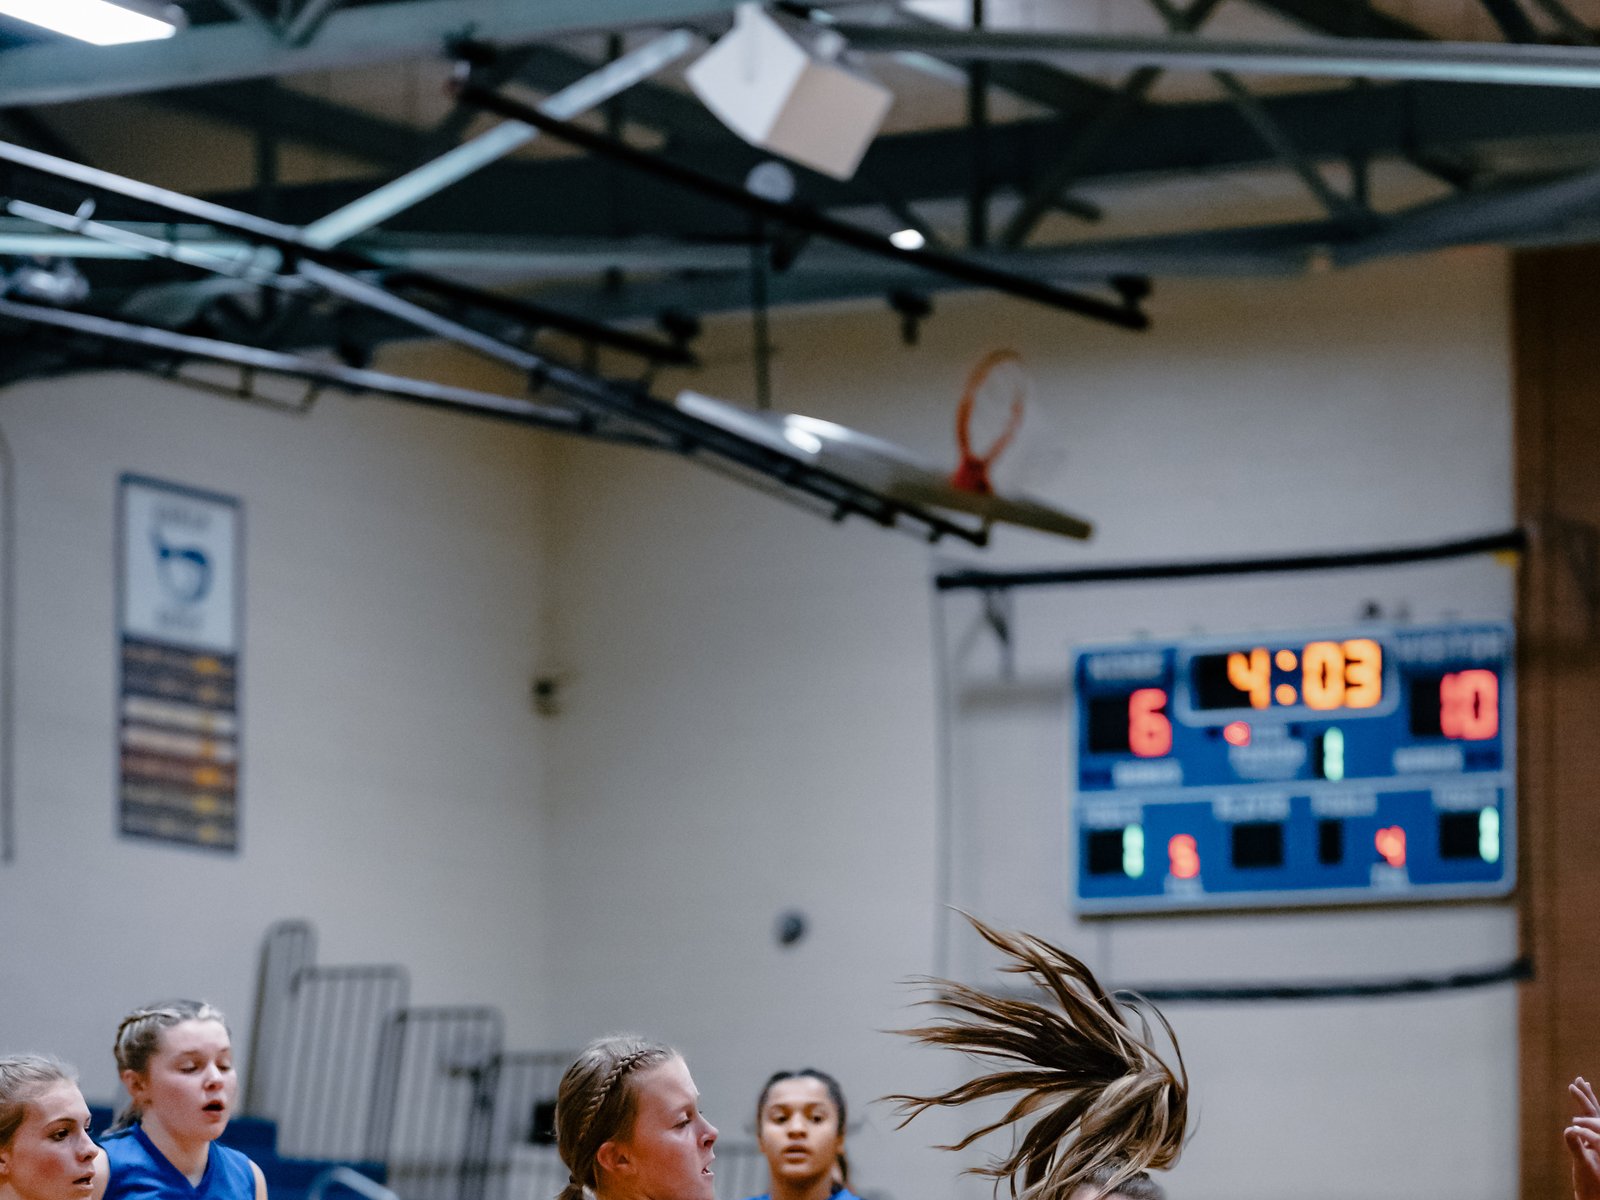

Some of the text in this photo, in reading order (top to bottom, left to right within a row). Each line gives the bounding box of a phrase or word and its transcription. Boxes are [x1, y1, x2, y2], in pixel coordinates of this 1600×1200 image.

[1227, 639, 1382, 710] 4:03
[1440, 669, 1498, 740] 10
[1128, 688, 1172, 757] 6
[1323, 726, 1344, 782] 1
[1122, 823, 1144, 878] 1
[1478, 806, 1500, 863] 1
